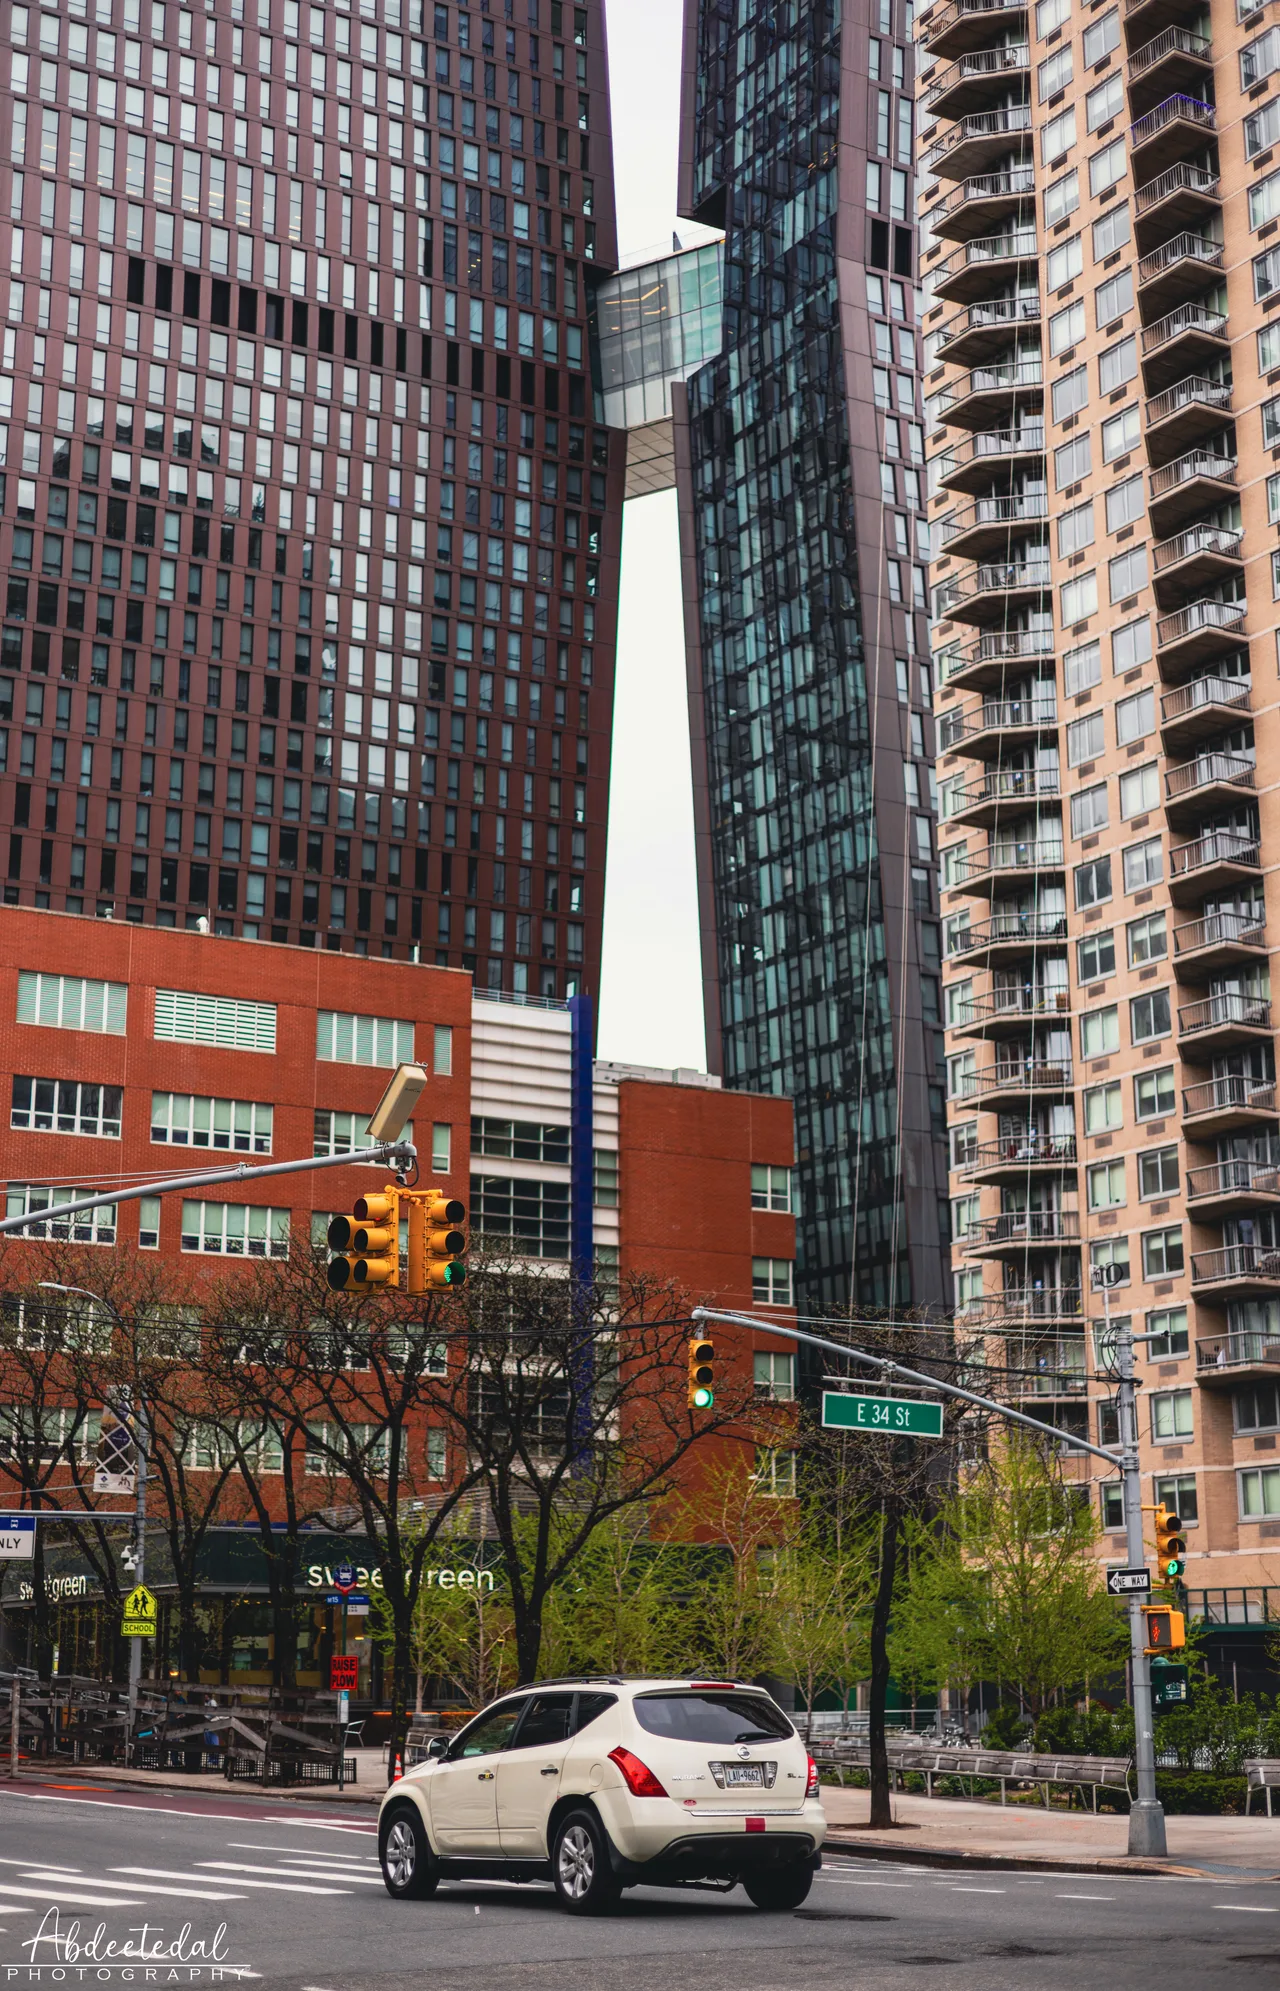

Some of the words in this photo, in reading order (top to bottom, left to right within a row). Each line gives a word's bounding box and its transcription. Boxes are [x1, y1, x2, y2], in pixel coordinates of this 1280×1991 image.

[857, 1403, 866, 1422] E
[871, 1404, 890, 1425] 34
[895, 1406, 910, 1427] St
[1113, 1577, 1126, 1588] ONE
[1131, 1575, 1145, 1586] WAY
[124, 1624, 153, 1633] SCHOOL
[332, 1659, 356, 1671] RAISE
[331, 1674, 355, 1687] PLOW
